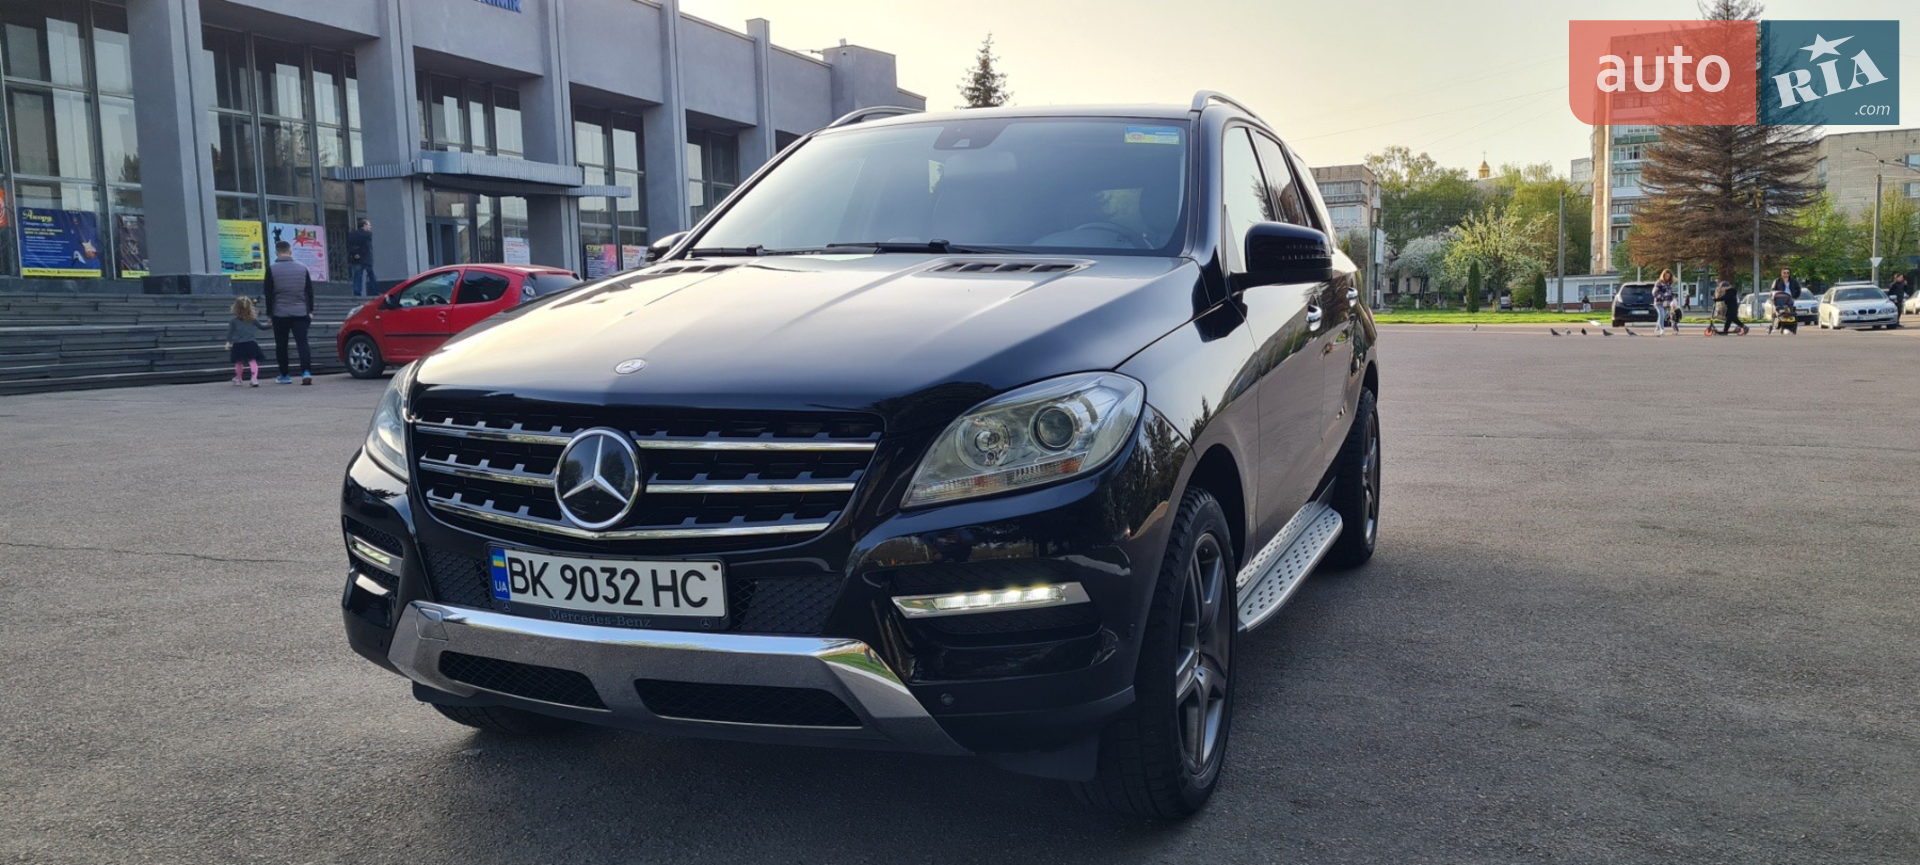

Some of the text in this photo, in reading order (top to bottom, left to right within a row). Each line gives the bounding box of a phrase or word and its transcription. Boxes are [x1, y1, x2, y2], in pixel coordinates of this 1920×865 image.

[495, 580, 508, 593] UA
[508, 557, 708, 608] BK 9032 HC
[549, 609, 652, 627] Mercedes-Benz
